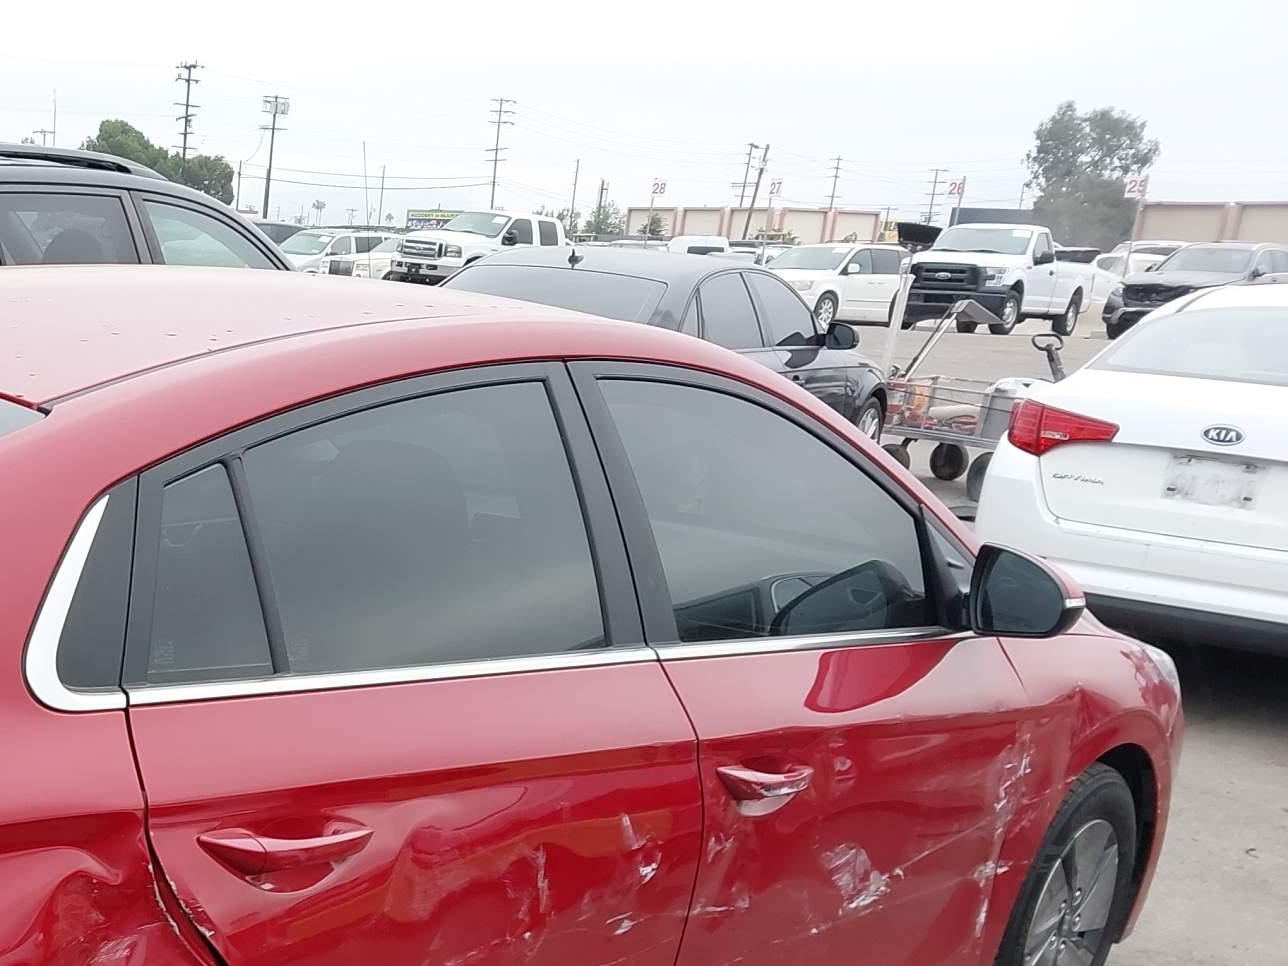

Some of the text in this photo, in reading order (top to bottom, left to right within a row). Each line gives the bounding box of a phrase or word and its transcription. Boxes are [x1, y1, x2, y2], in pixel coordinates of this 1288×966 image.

[652, 182, 666, 194] 28
[769, 181, 782, 194] 27
[1208, 428, 1238, 441] KIA
